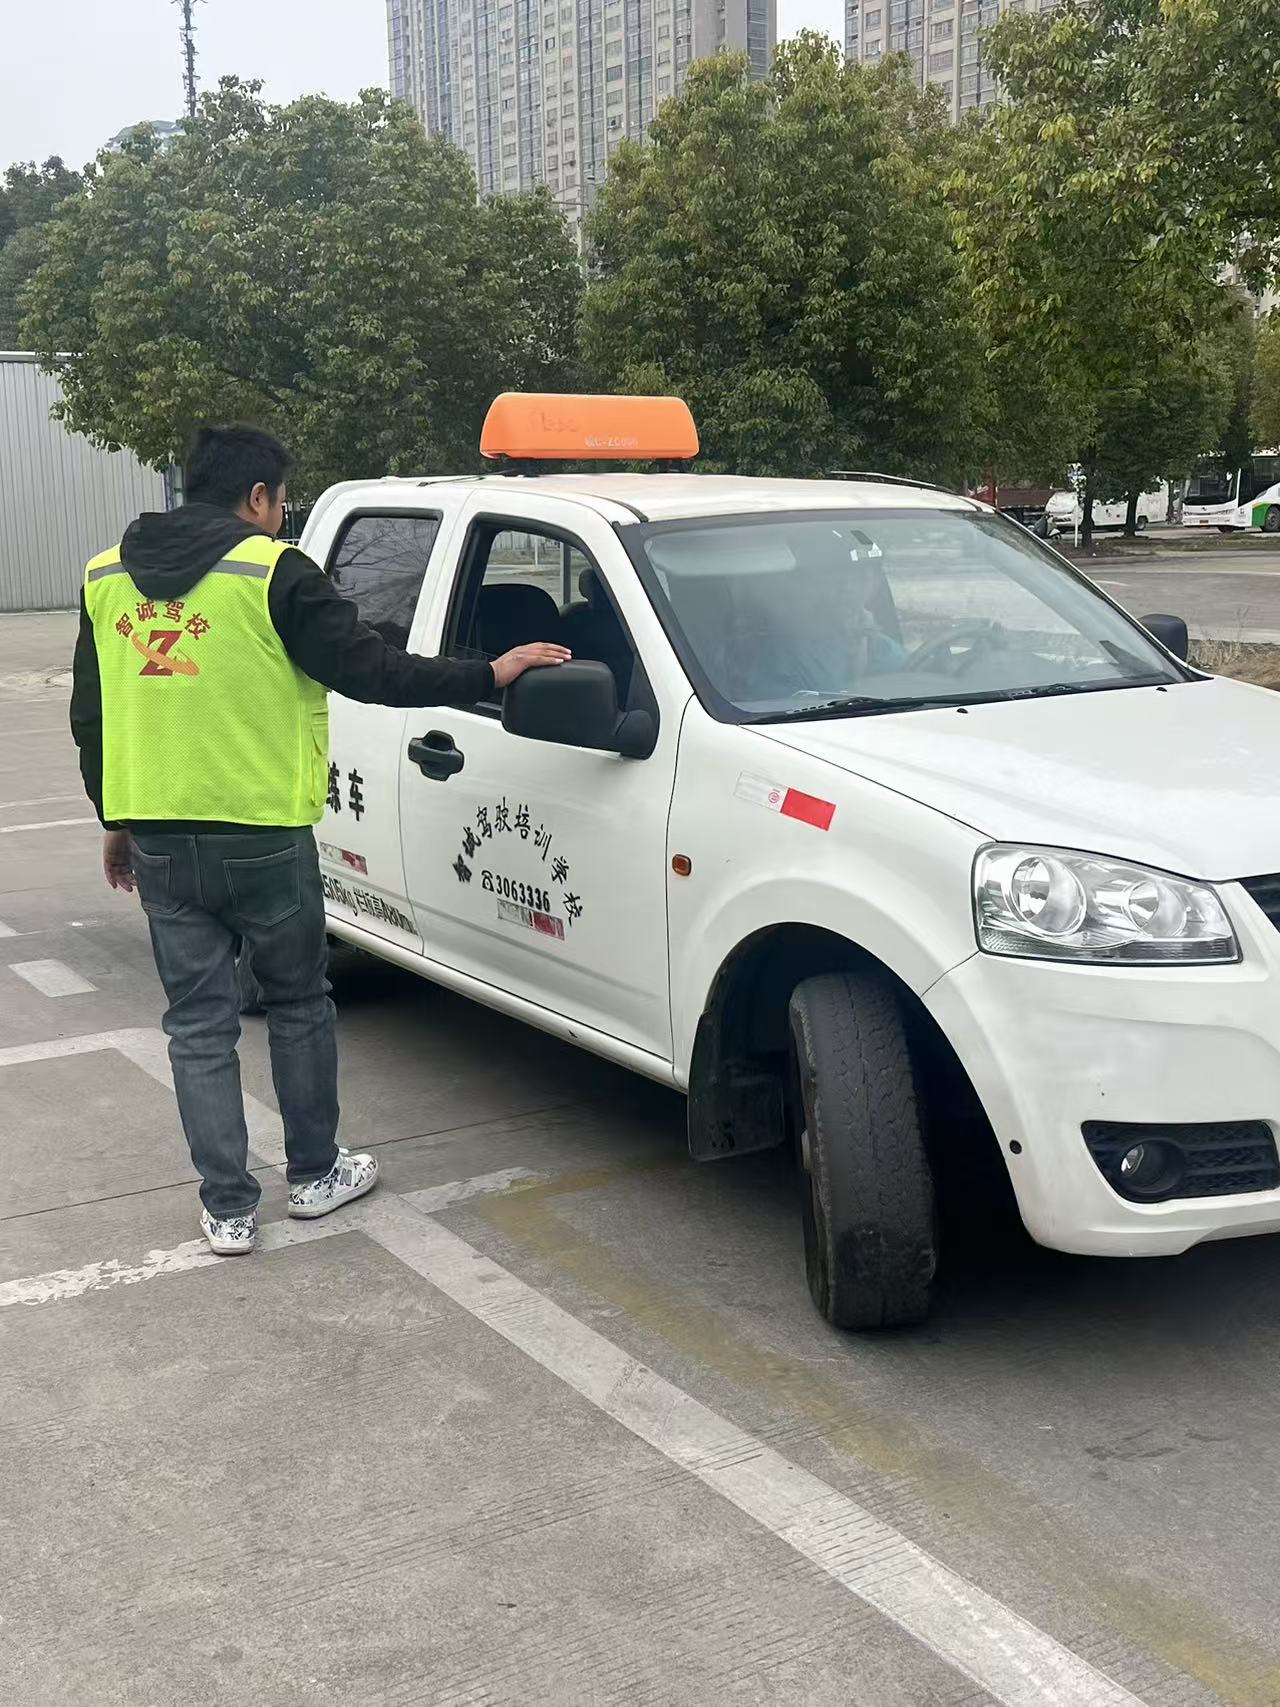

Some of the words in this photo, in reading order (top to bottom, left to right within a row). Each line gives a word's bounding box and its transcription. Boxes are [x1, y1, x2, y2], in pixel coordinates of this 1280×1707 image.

[115, 598, 212, 641] 智诚驾校
[139, 630, 184, 676] Z
[452, 796, 584, 927] 智诚驾驶培训学校
[495, 874, 551, 913] 3063336
